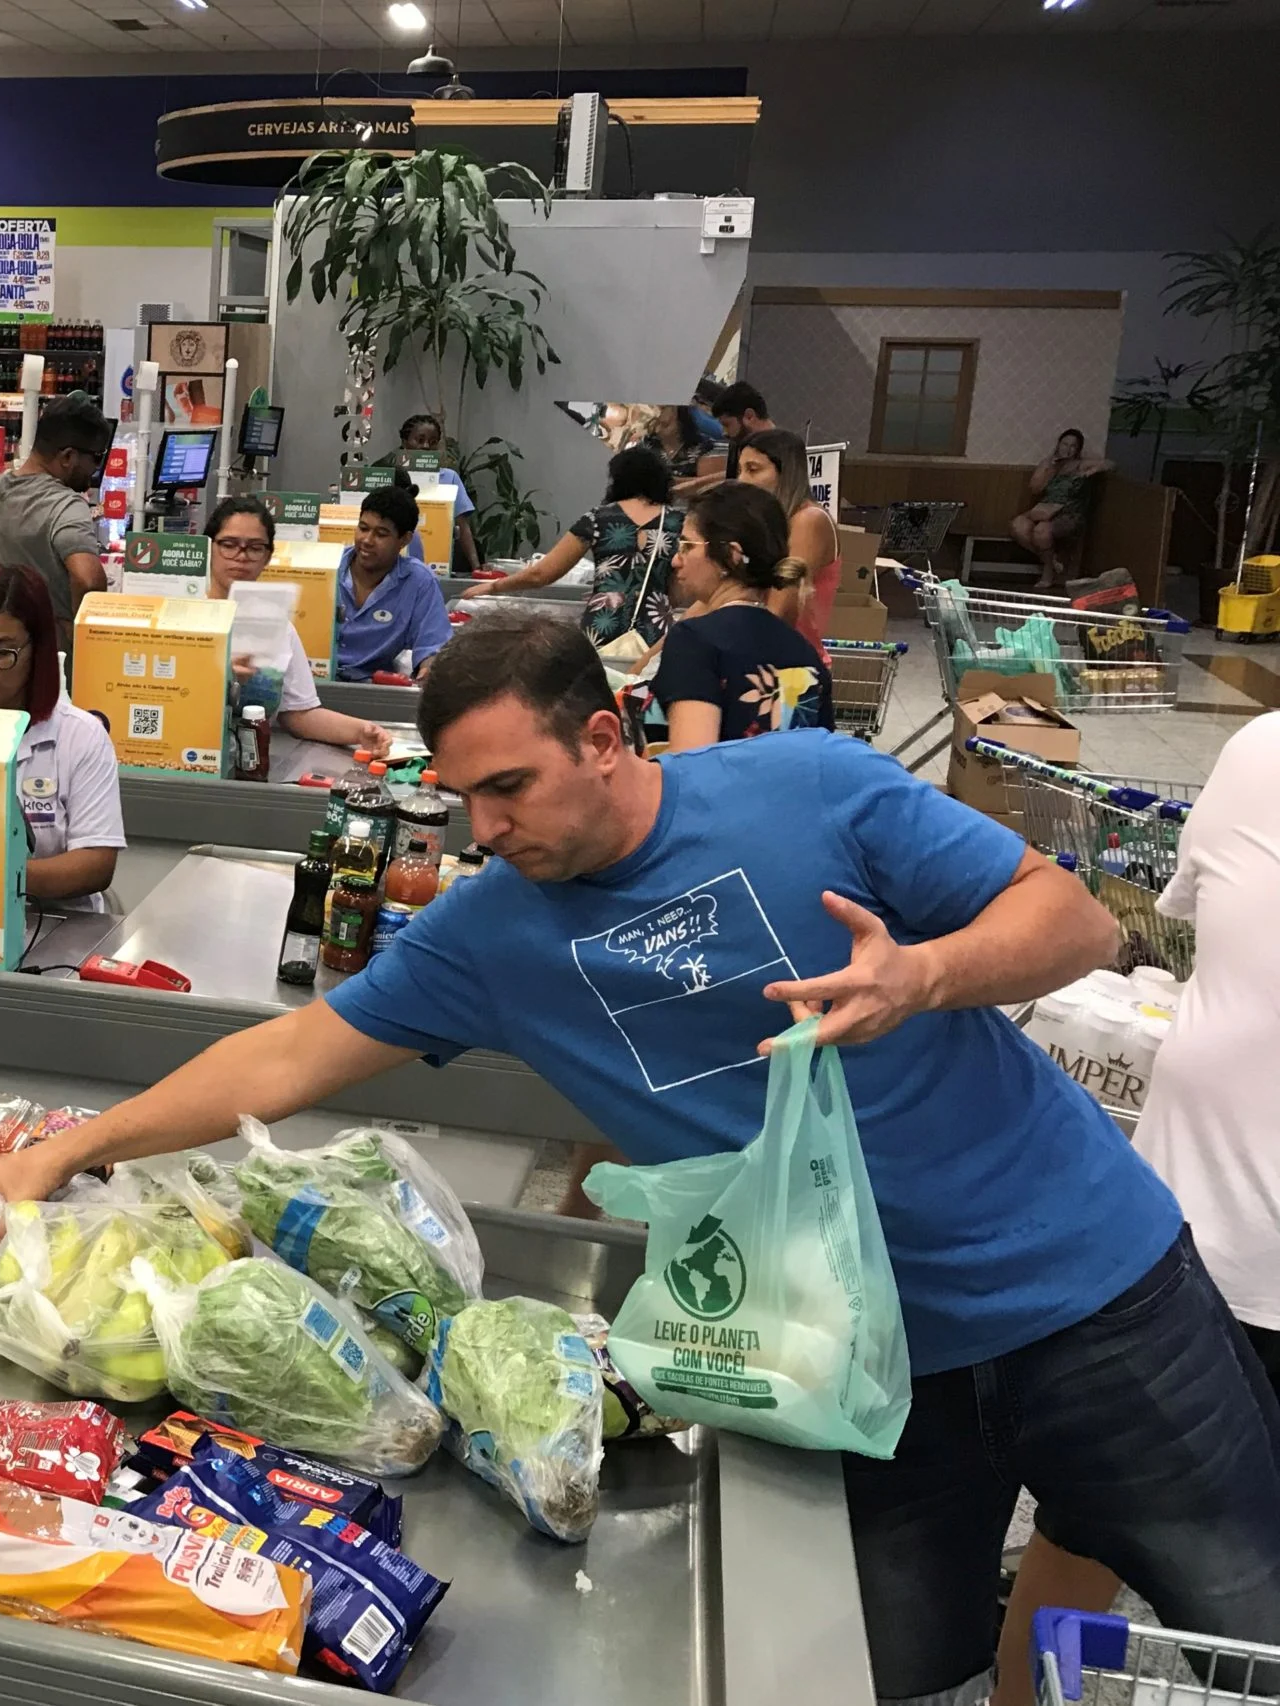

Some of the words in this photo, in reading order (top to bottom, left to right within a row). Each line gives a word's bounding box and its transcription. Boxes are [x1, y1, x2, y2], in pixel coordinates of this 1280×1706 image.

[248, 122, 314, 136] CERVEJAS
[317, 121, 409, 134] ARTNAIS
[162, 550, 184, 558] AGORA
[186, 550, 190, 558] É
[192, 550, 205, 560] LEI,
[162, 559, 178, 567] VOCÊ
[180, 559, 202, 568] SABIA?
[618, 930, 644, 944] MAN,
[657, 907, 693, 925] NEED...
[644, 915, 701, 954] VANS!!
[654, 1320, 687, 1342] LEVE
[690, 1324, 698, 1344] O
[703, 1325, 760, 1351] PLANETA
[673, 1347, 702, 1369] COM
[272, 1473, 337, 1502] ADRIA
